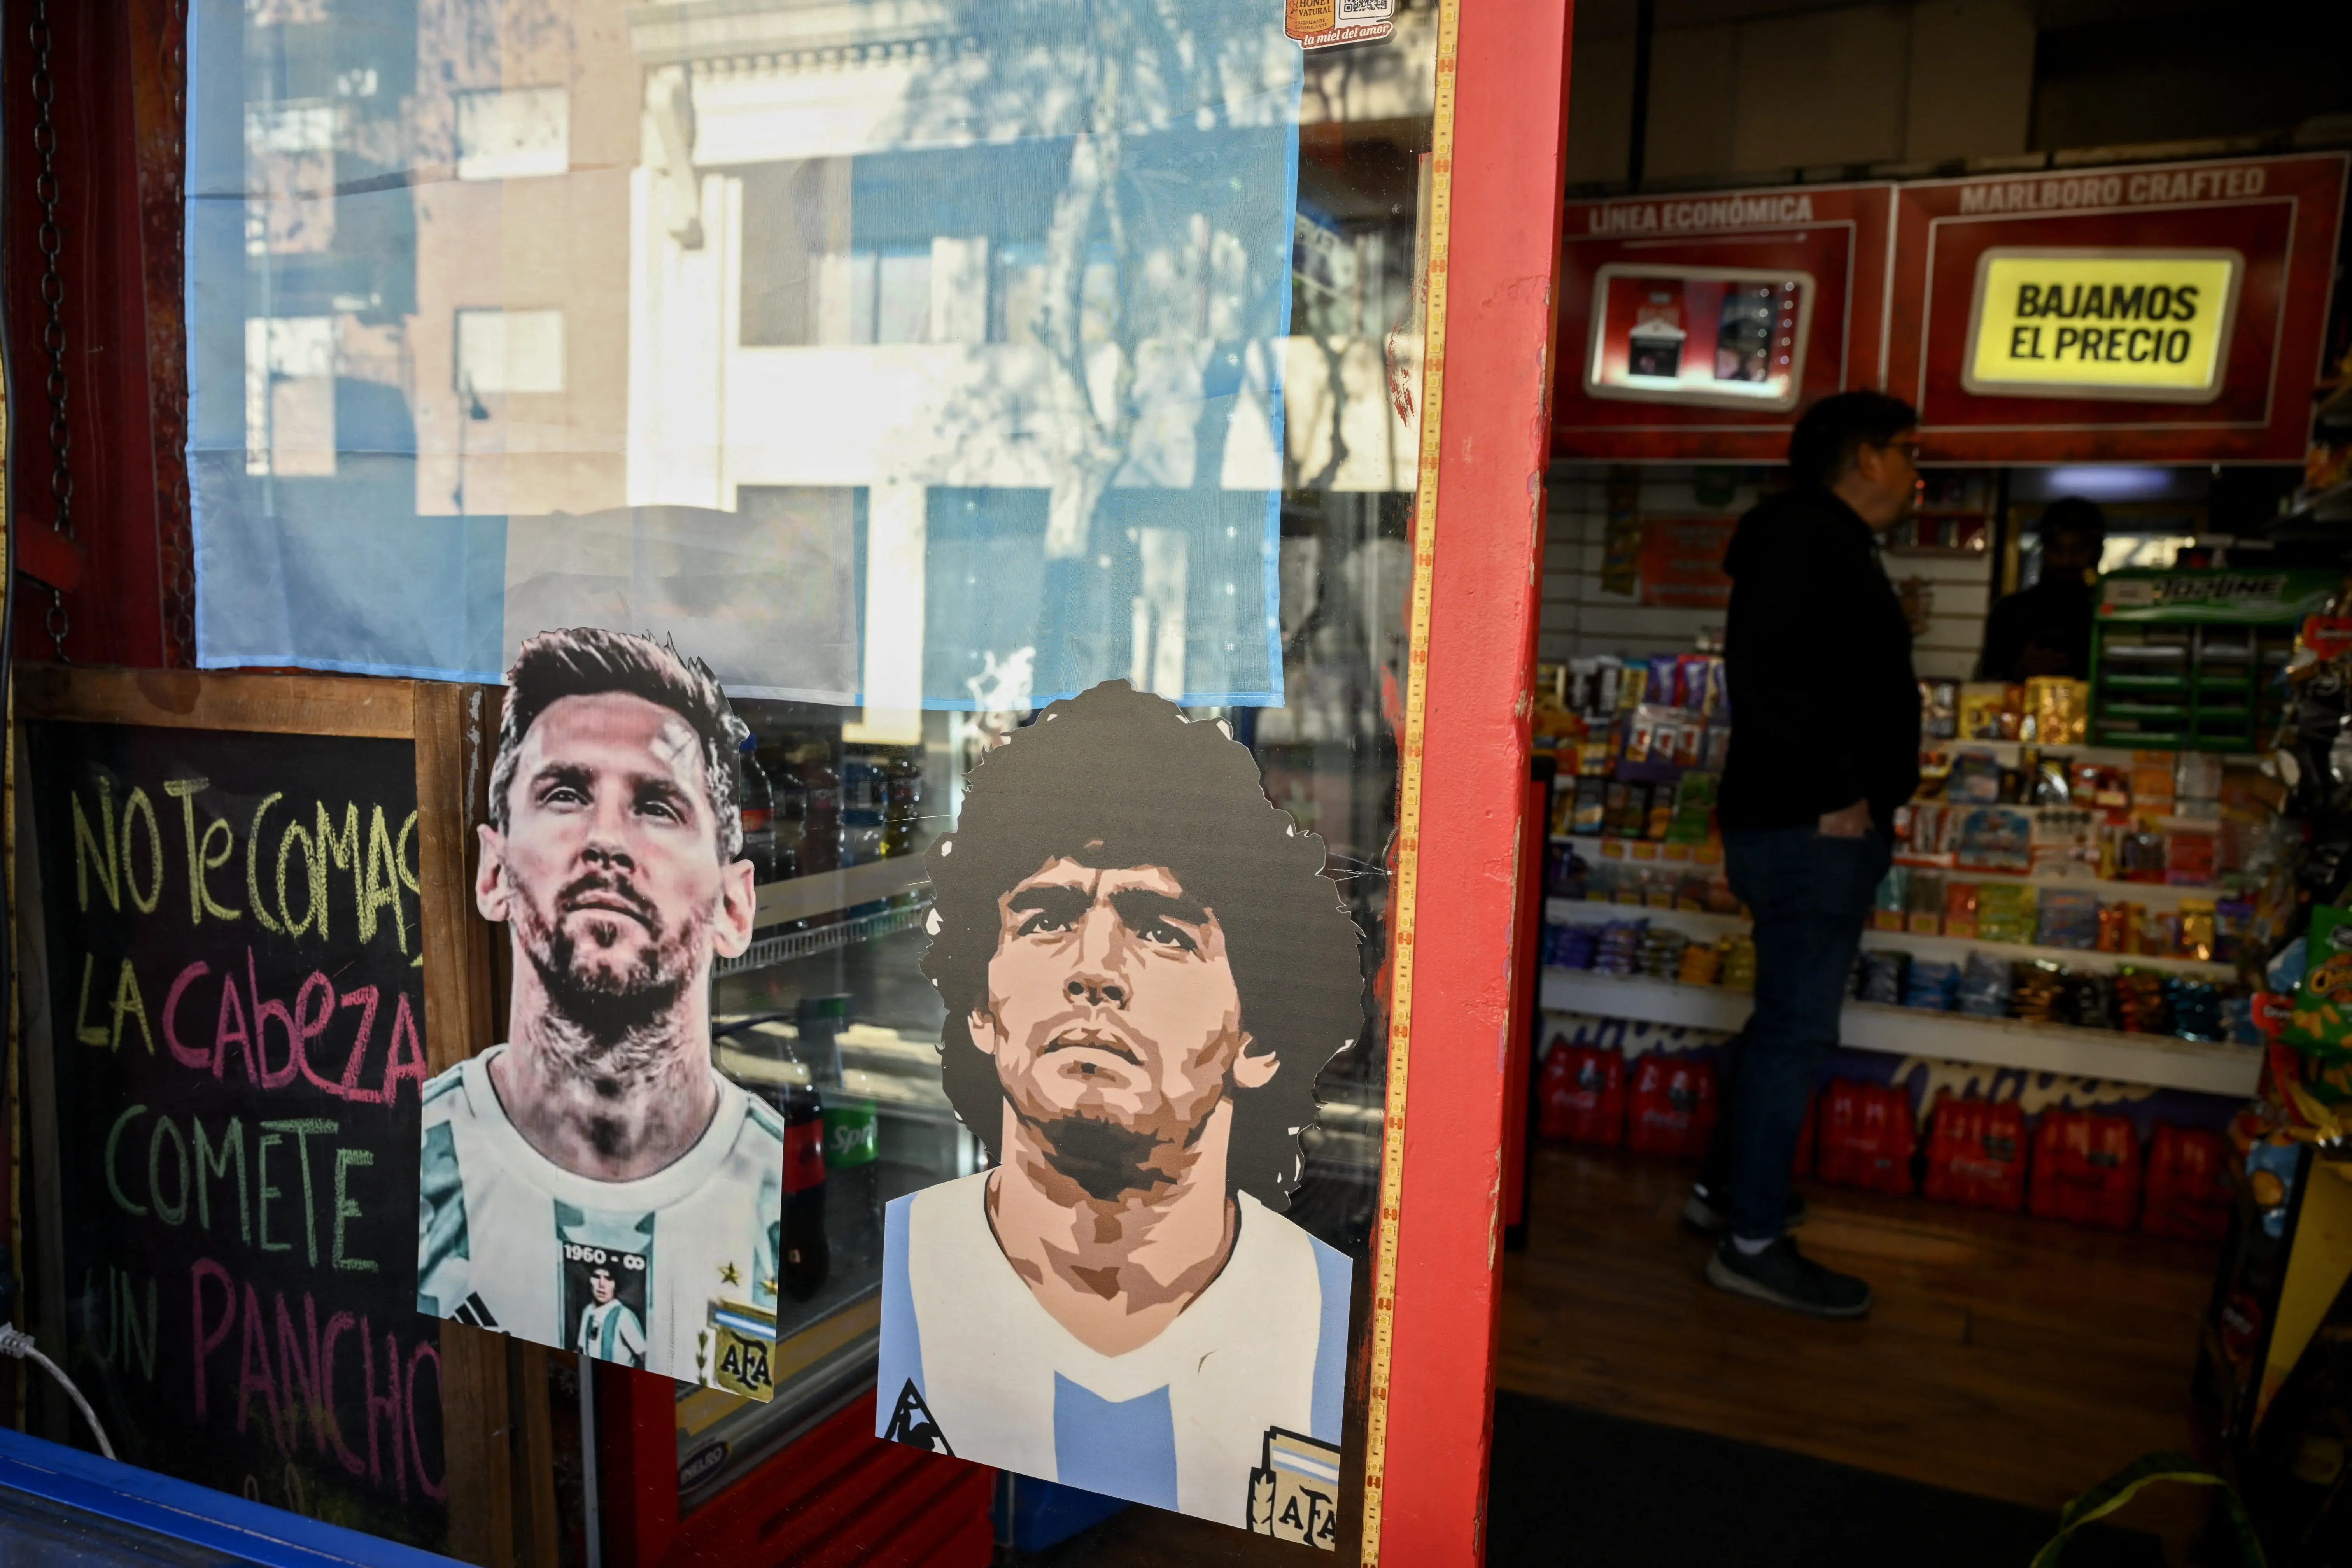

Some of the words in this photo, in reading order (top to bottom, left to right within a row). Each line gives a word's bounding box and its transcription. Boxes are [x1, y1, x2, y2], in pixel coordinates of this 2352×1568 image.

[1304, 34, 1315, 46] la
[1317, 30, 1341, 44] miel
[1342, 27, 1359, 39] del
[1359, 25, 1389, 37] amor
[1589, 201, 1658, 233] LÍNEA
[1663, 193, 1813, 229] ECONÓMICA
[1960, 176, 2121, 214] MARLBORO
[2128, 167, 2265, 203] CRAFTED
[2016, 284, 2199, 321] BAJAMOS
[2010, 326, 2045, 358] EL
[2054, 327, 2191, 363] PRECIO
[72, 776, 163, 914] NO
[77, 953, 155, 1056] LA
[830, 1118, 877, 1154] Spri
[105, 1104, 379, 1274] COMETE
[564, 1243, 607, 1265] 1960
[83, 1262, 158, 1383] UN
[191, 1257, 447, 1504] PANCHO
[721, 1331, 772, 1391] AFA
[1278, 1484, 1336, 1548] AFA
